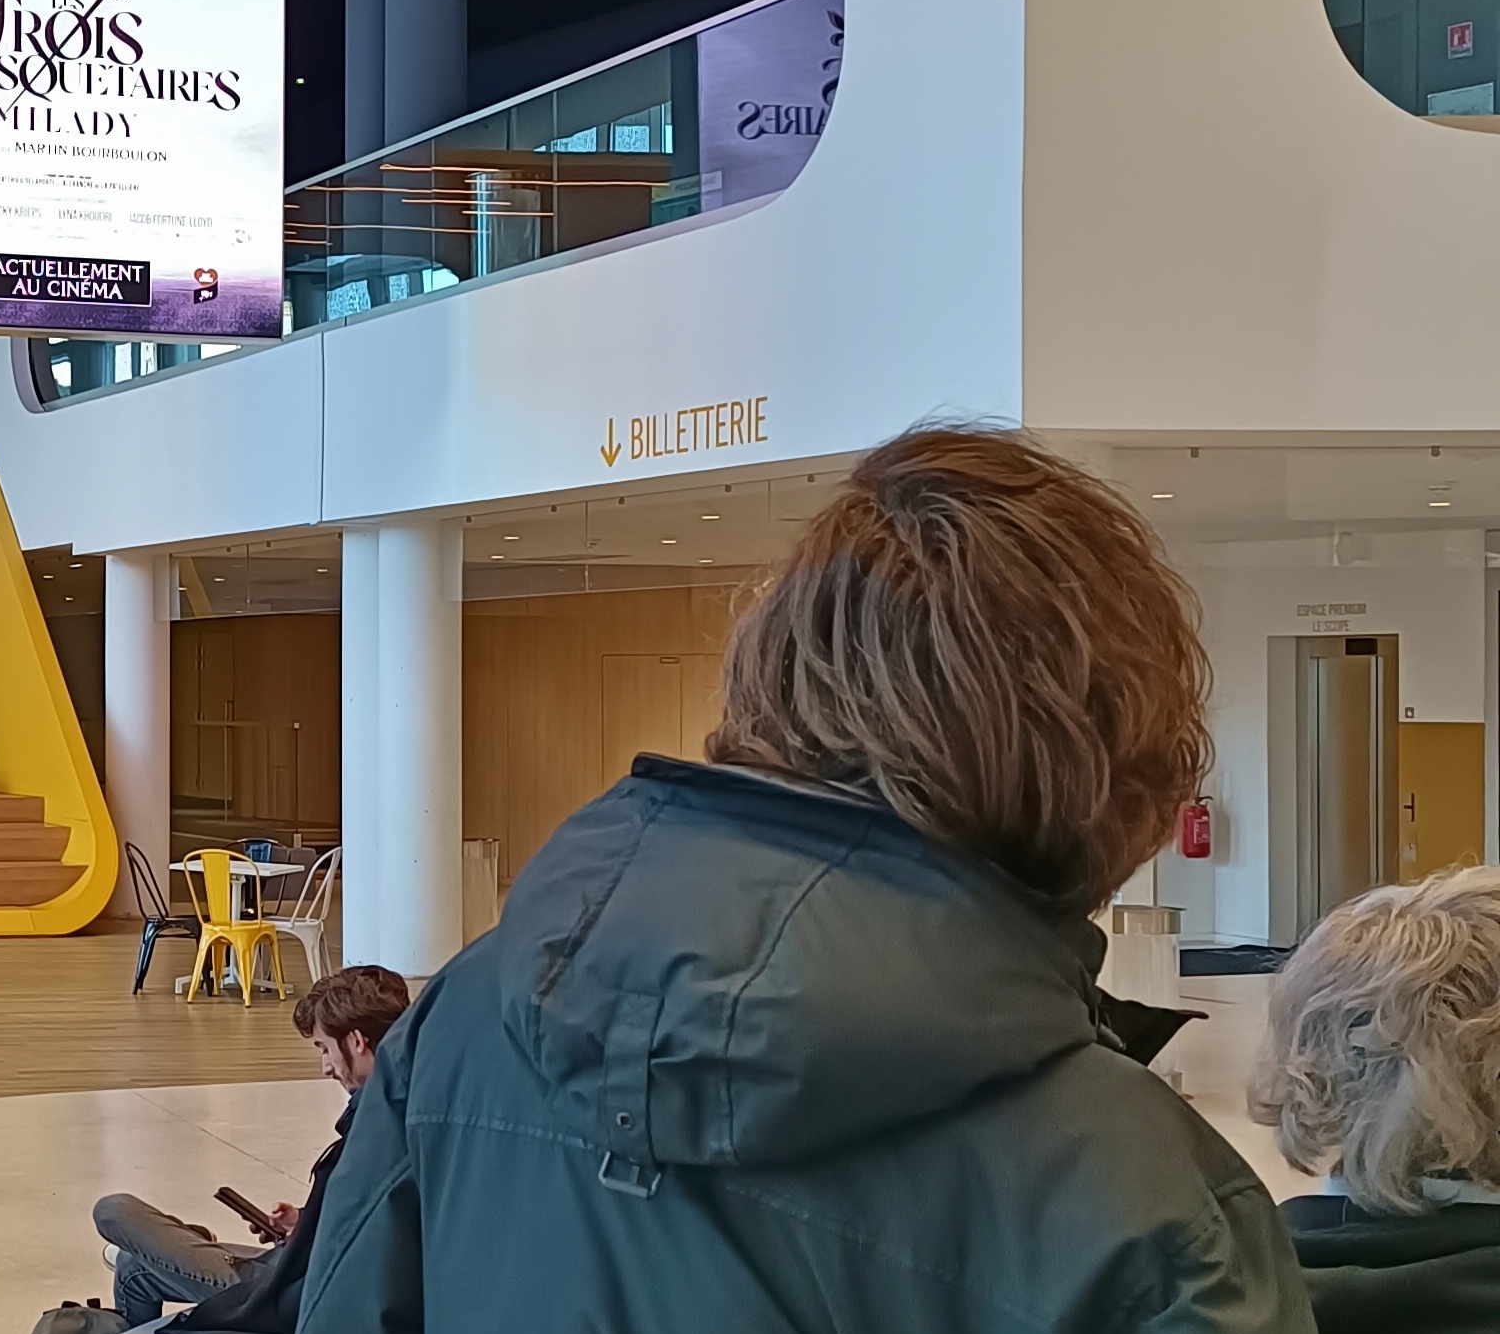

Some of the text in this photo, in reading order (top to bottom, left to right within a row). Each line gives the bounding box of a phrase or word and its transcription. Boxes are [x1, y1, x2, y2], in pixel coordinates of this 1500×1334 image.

[14, 141, 68, 156] MARTIN
[72, 144, 168, 162] BOURBOULON
[11, 277, 124, 300] AU CINÉMA
[630, 395, 768, 461] BILLETTERIE
